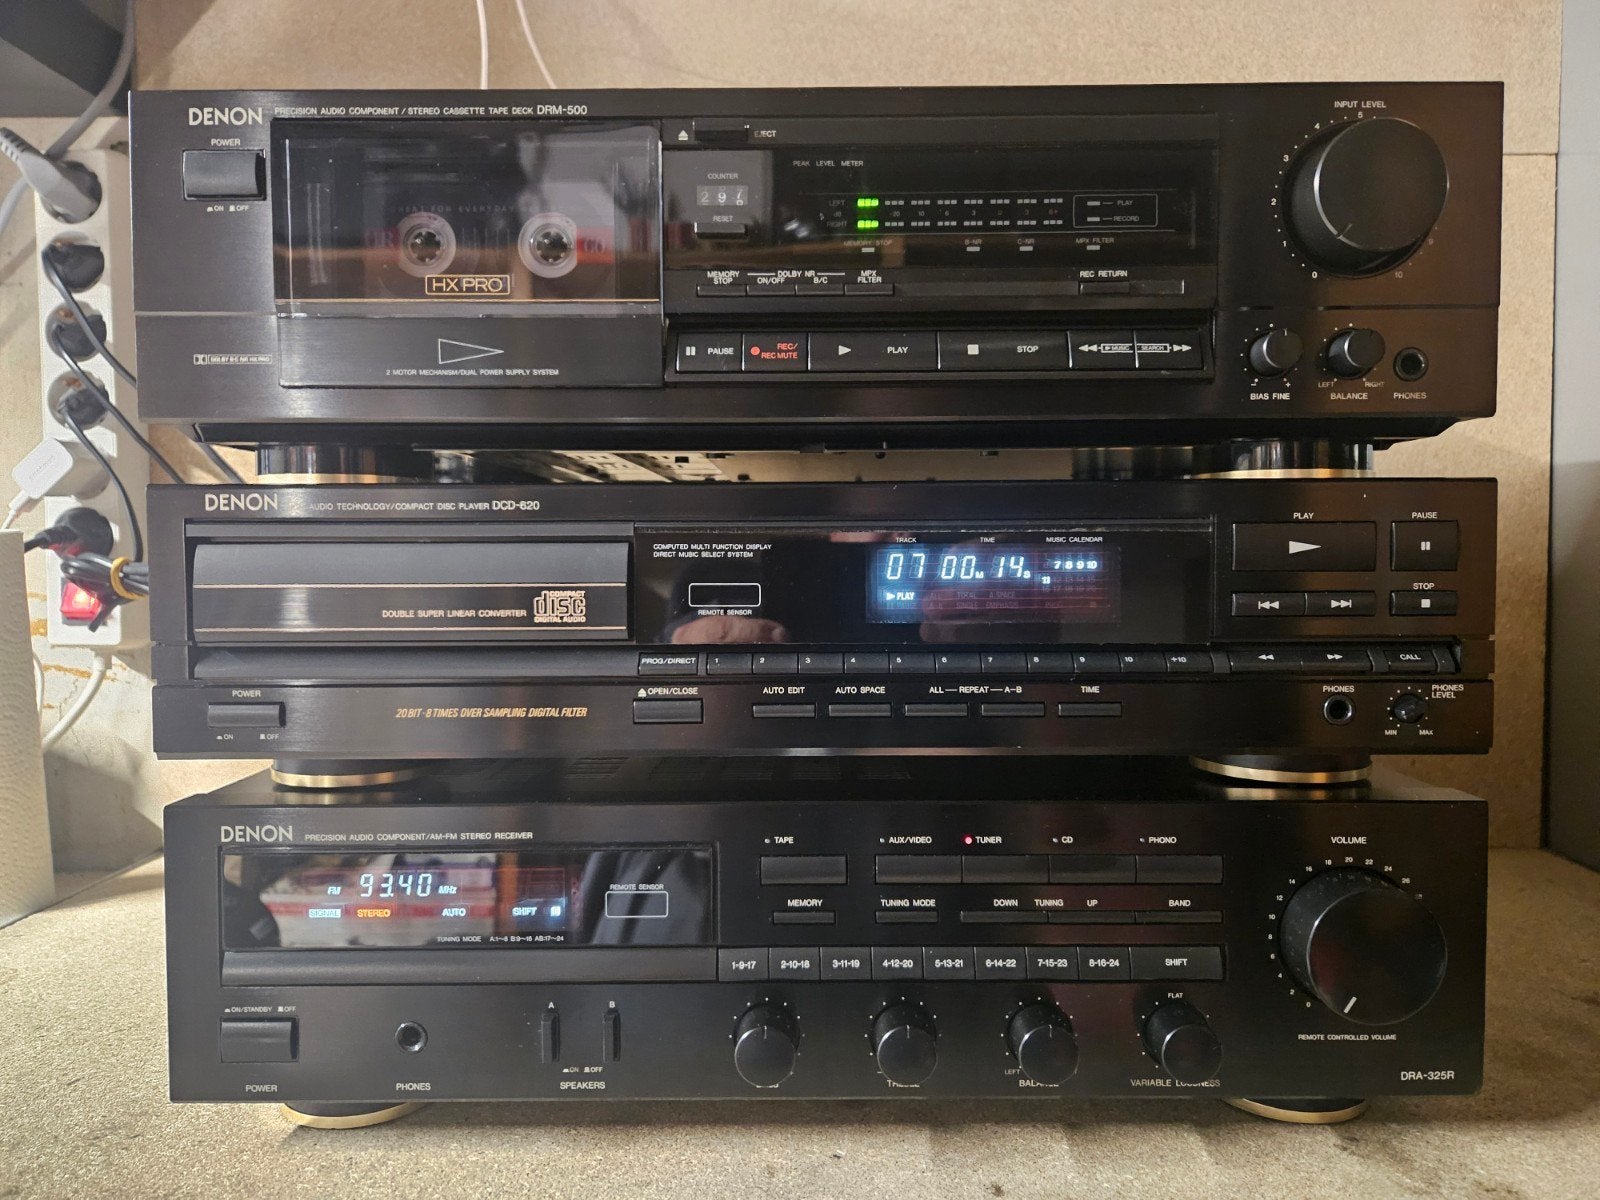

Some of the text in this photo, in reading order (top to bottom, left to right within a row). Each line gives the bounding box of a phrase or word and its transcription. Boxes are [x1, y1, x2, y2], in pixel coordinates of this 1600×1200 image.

[274, 104, 588, 116] PRECISION AUDIO COMPONENT STEREO CASSETTE TAPE DECK DRM-500
[188, 106, 263, 126] DENON
[210, 138, 241, 146] POWER
[432, 278, 503, 292] HX PRO
[707, 347, 734, 355] PAUSE
[205, 492, 278, 512] DENON
[337, 500, 540, 511] TECHNOLOGY/COMPACT DISC PLAYER DCD-620
[1294, 512, 1314, 520] PLAY
[886, 553, 926, 580] 07
[1053, 561, 1084, 569] 7 9
[896, 592, 915, 600] PLAY
[382, 610, 526, 618] DOUBLE SUPER LINEAR CONVERTER
[648, 688, 698, 696] OPEN/CLOSE
[1322, 685, 1355, 693] PHONES
[433, 707, 588, 717] TIMES OVER SAMPLING DIGITAL FILTER
[220, 825, 293, 842] DENON
[305, 832, 534, 842] PRECISION AUDIO COMPONENT/AM-FM STEREO RECEIVER
[1331, 836, 1367, 844] VOLUME
[360, 873, 432, 898] 93.40
[357, 907, 537, 918] STEREO AUTO SHIFT
[731, 961, 756, 970] 1-9-17
[780, 960, 810, 969] 2-10-18
[832, 960, 860, 968] 3-11-19
[882, 960, 914, 968] 4-12-20
[934, 960, 964, 968] 5-13-21
[985, 959, 1017, 968] 6-14-22
[1038, 959, 1068, 967] 7-15-23
[1089, 958, 1120, 967] 8-16-24
[1165, 958, 1188, 966] SHIFT
[1401, 1070, 1454, 1081] DRA-325R
[396, 1083, 432, 1091] PHONES
[560, 1081, 606, 1090] SPEAKERS
[1130, 1079, 1172, 1087] VARIABLE
[245, 1084, 278, 1093] POWER
